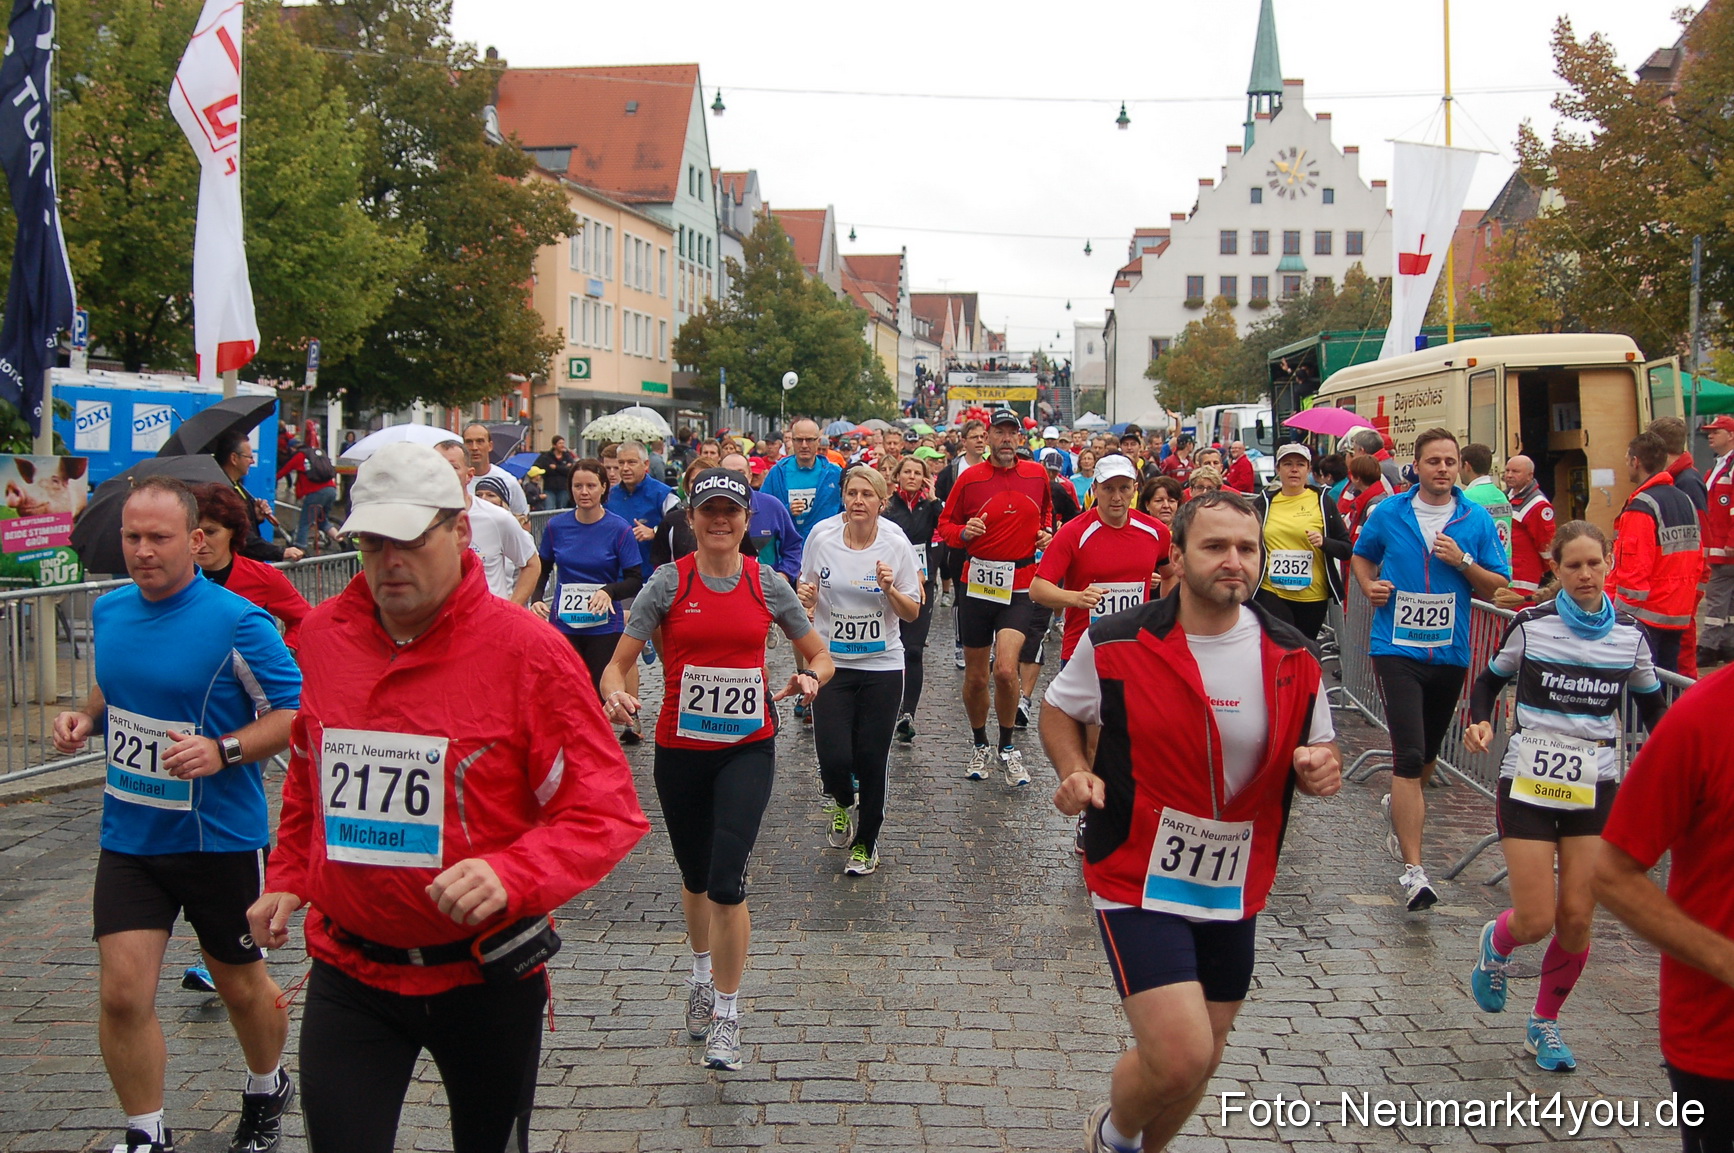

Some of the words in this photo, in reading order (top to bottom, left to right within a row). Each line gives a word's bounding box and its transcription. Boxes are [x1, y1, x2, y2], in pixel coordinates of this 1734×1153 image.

[571, 360, 588, 377] D
[976, 390, 1007, 398] START
[1394, 387, 1443, 413] Bayerisches
[76, 407, 109, 430] DIXI
[133, 410, 169, 431] DIXI
[1393, 416, 1416, 434] Rotes
[1394, 438, 1414, 457] Kreuz
[695, 475, 746, 496] adidas
[40, 558, 61, 569] UND
[1273, 559, 1308, 575] 2352
[40, 563, 79, 586] DU?
[977, 568, 1004, 587] 315
[564, 594, 591, 611] 221
[1397, 596, 1416, 604] PARTL
[830, 612, 846, 620] PARTL
[1400, 605, 1450, 627] 2429
[834, 620, 880, 640] 2970
[1408, 631, 1440, 640] Andreas
[846, 644, 868, 652] Silvia
[683, 671, 711, 682] PARTL
[713, 675, 752, 684] Neumarkt
[1541, 671, 1620, 695] Triathlon
[688, 684, 757, 715] 2128
[1207, 696, 1240, 707] eister
[1549, 691, 1610, 707] Regensburg
[109, 714, 132, 730] PARTL
[701, 719, 740, 733] Marion
[113, 730, 160, 773] 221
[324, 742, 358, 756] PARTL
[361, 745, 421, 761] Neumarkt
[1521, 736, 1548, 746] PARTL
[1549, 741, 1585, 753] Neumarkt
[1532, 749, 1582, 782] 523
[120, 774, 165, 796] Michael
[329, 761, 430, 817] 2176
[1534, 783, 1572, 799] Sandra
[339, 823, 405, 847] Michael
[1161, 817, 1198, 837] PARTL
[1160, 835, 1241, 881] 3111
